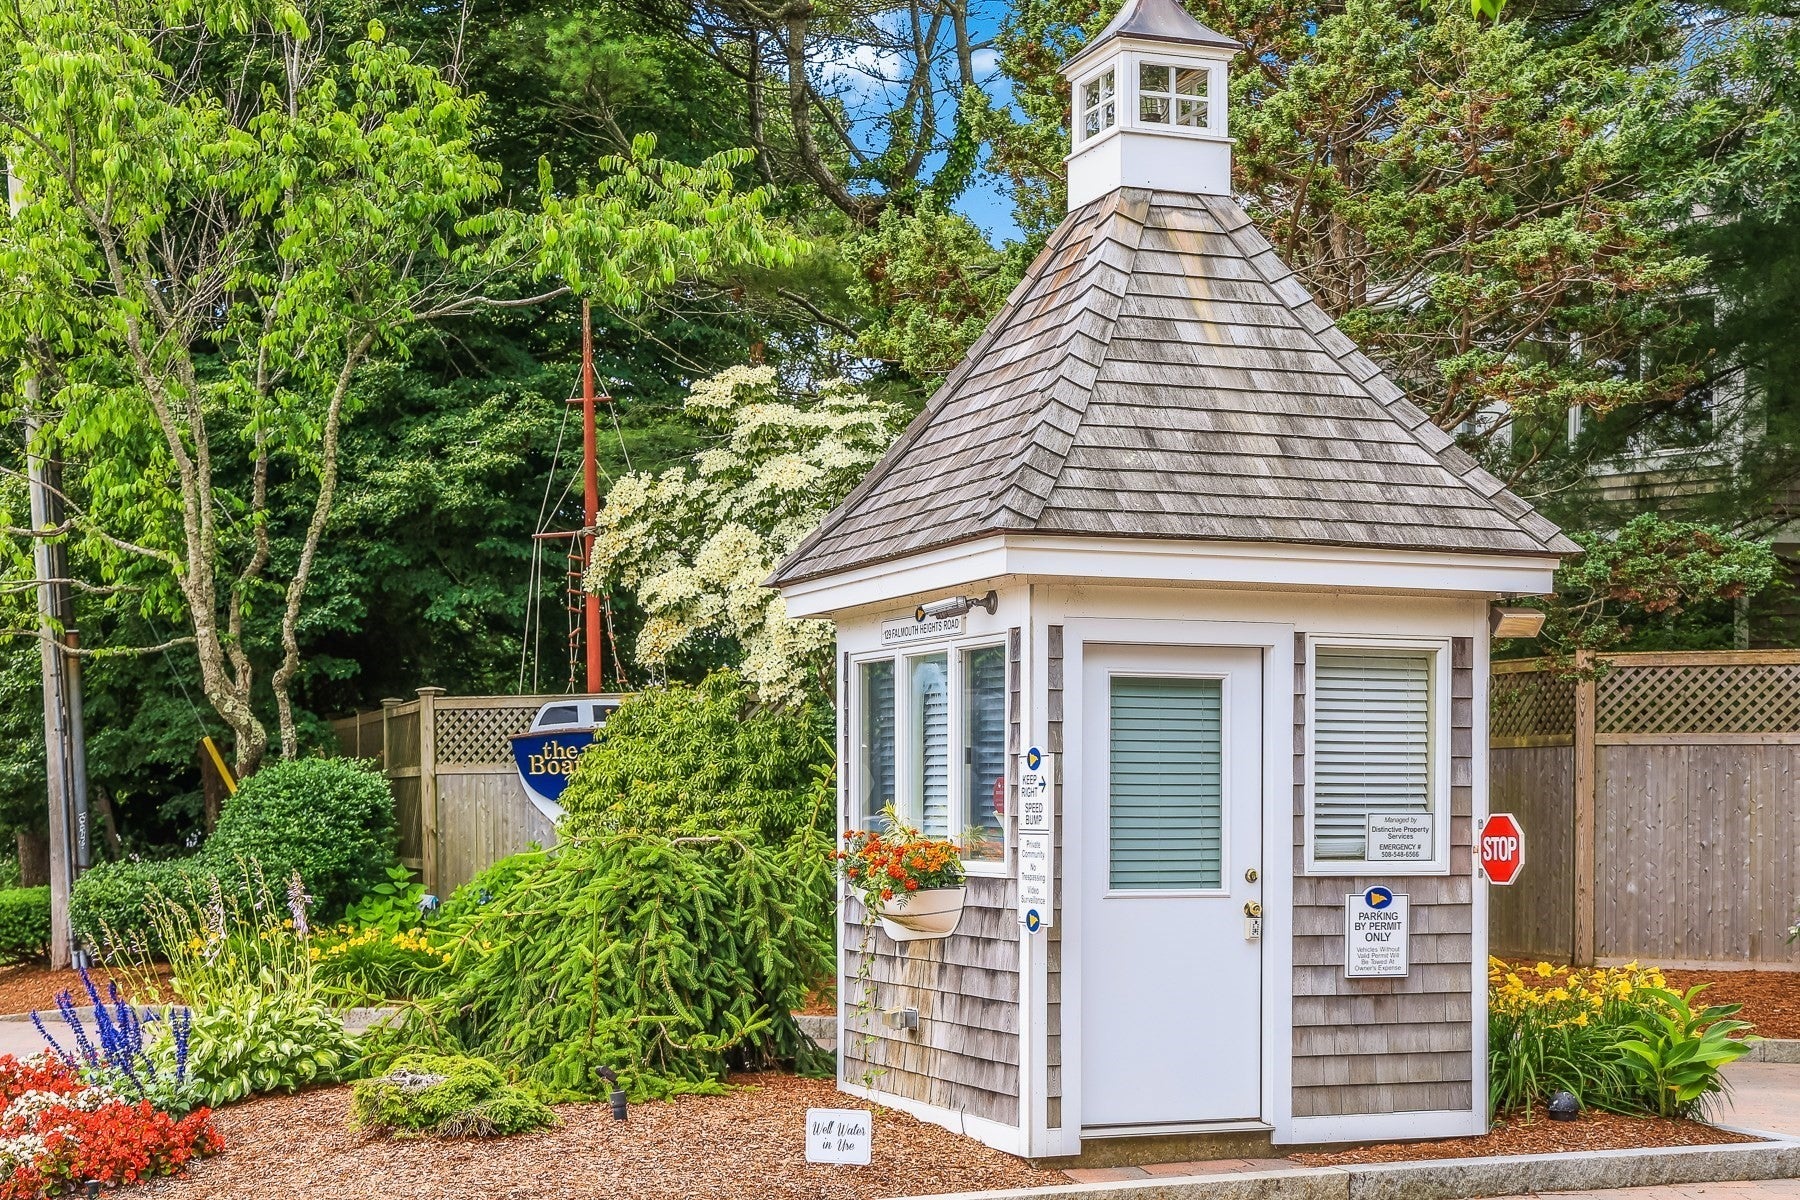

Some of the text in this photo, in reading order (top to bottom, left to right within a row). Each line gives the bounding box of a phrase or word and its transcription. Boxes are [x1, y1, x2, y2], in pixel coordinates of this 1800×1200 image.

[892, 625, 919, 638] FALMOUTH
[920, 621, 942, 634] HEIGHTS
[944, 618, 959, 630] ROAD
[542, 740, 578, 760] the
[1022, 774, 1038, 785] KEEP
[1022, 787, 1038, 798] RIGHT
[1025, 802, 1044, 813] SPEED
[1026, 814, 1042, 825] BUMP
[1384, 816, 1418, 824] Managed by
[1026, 840, 1040, 849] Private
[1483, 836, 1517, 862] STOP
[1022, 850, 1045, 860] Community
[1030, 864, 1036, 872] No
[1022, 872, 1046, 884] Trespassing
[1027, 886, 1040, 894] Video
[1358, 912, 1398, 920] PARKING
[1354, 922, 1402, 930] BY PERMIT
[1365, 932, 1392, 942] ONLY
[812, 1120, 866, 1136] Well Water
[822, 1137, 856, 1152] in Use
